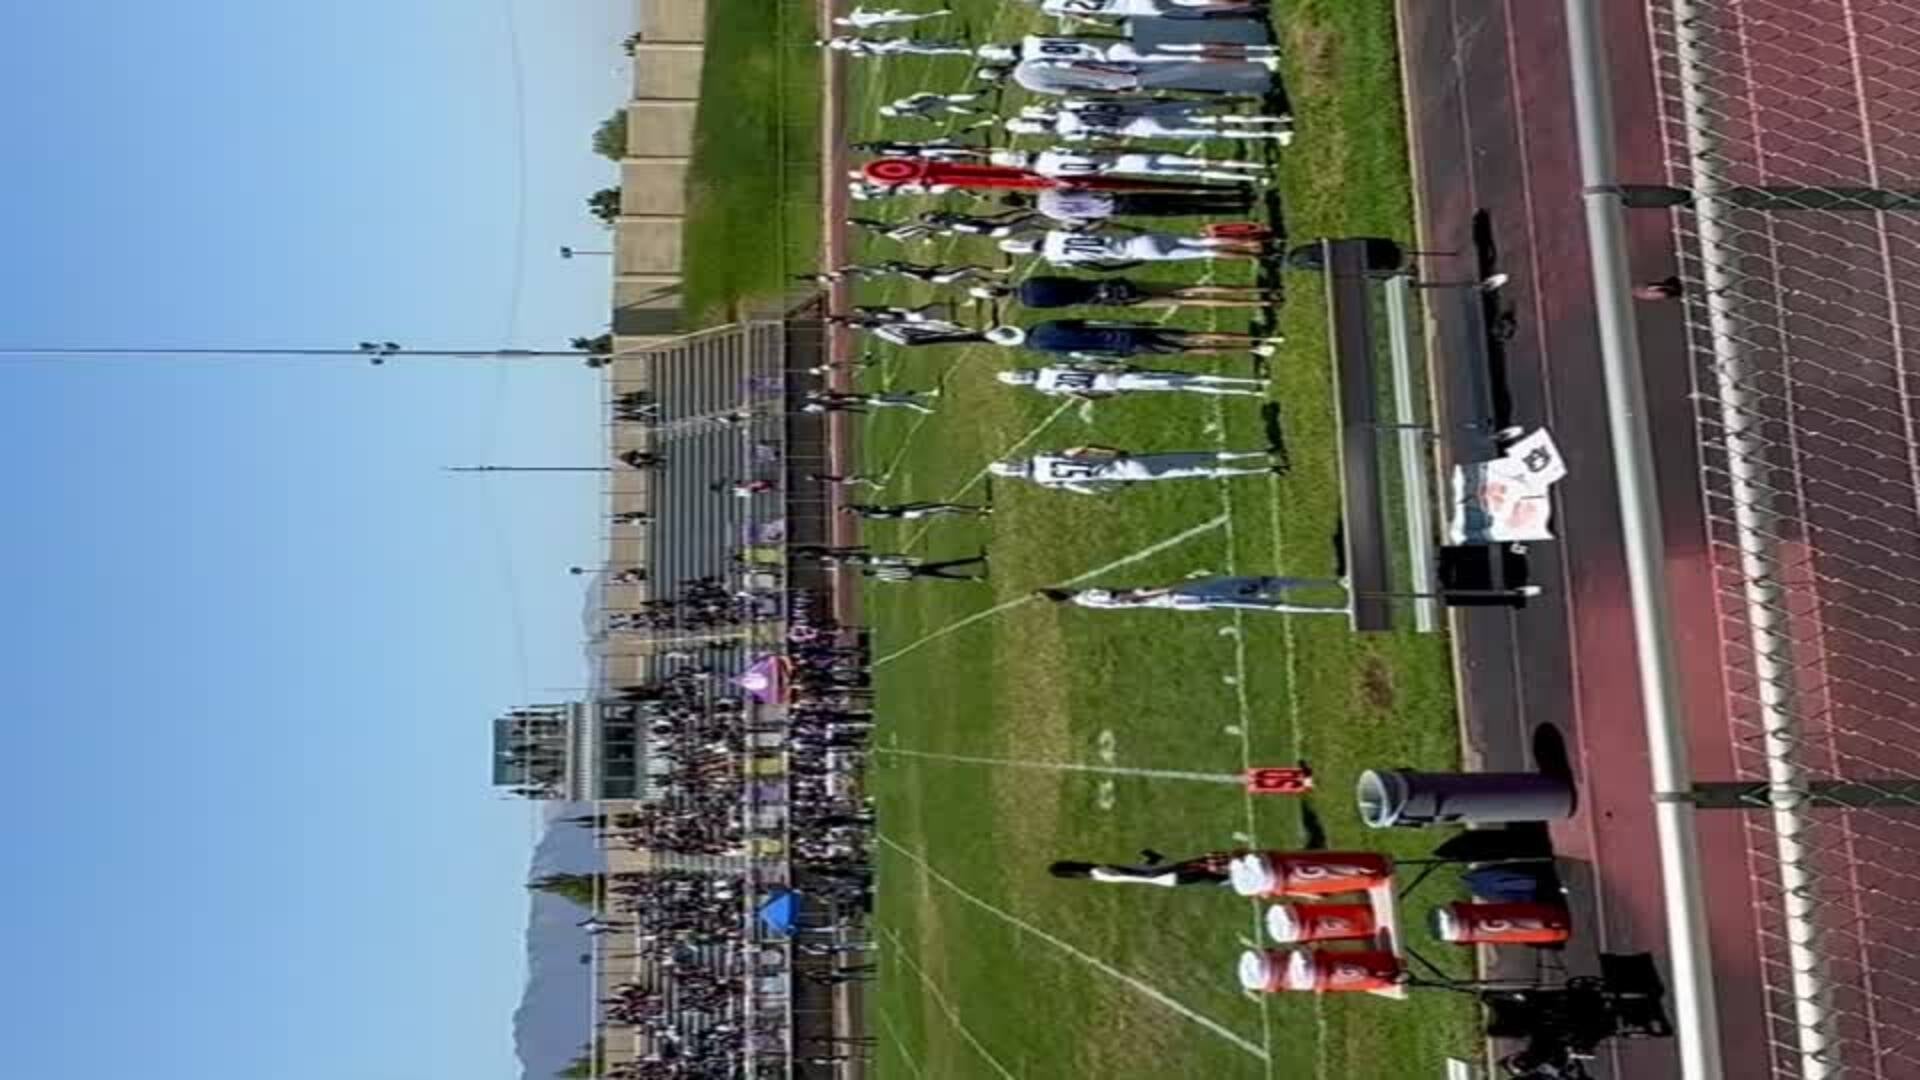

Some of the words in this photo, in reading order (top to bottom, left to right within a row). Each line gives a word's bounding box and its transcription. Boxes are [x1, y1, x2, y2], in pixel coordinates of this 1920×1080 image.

[1063, 0, 1104, 10] 2
[1063, 237, 1105, 255] 70
[1050, 462, 1092, 478] 57
[1254, 770, 1302, 790] 50
[1292, 865, 1327, 880] G
[1479, 920, 1508, 932] G
